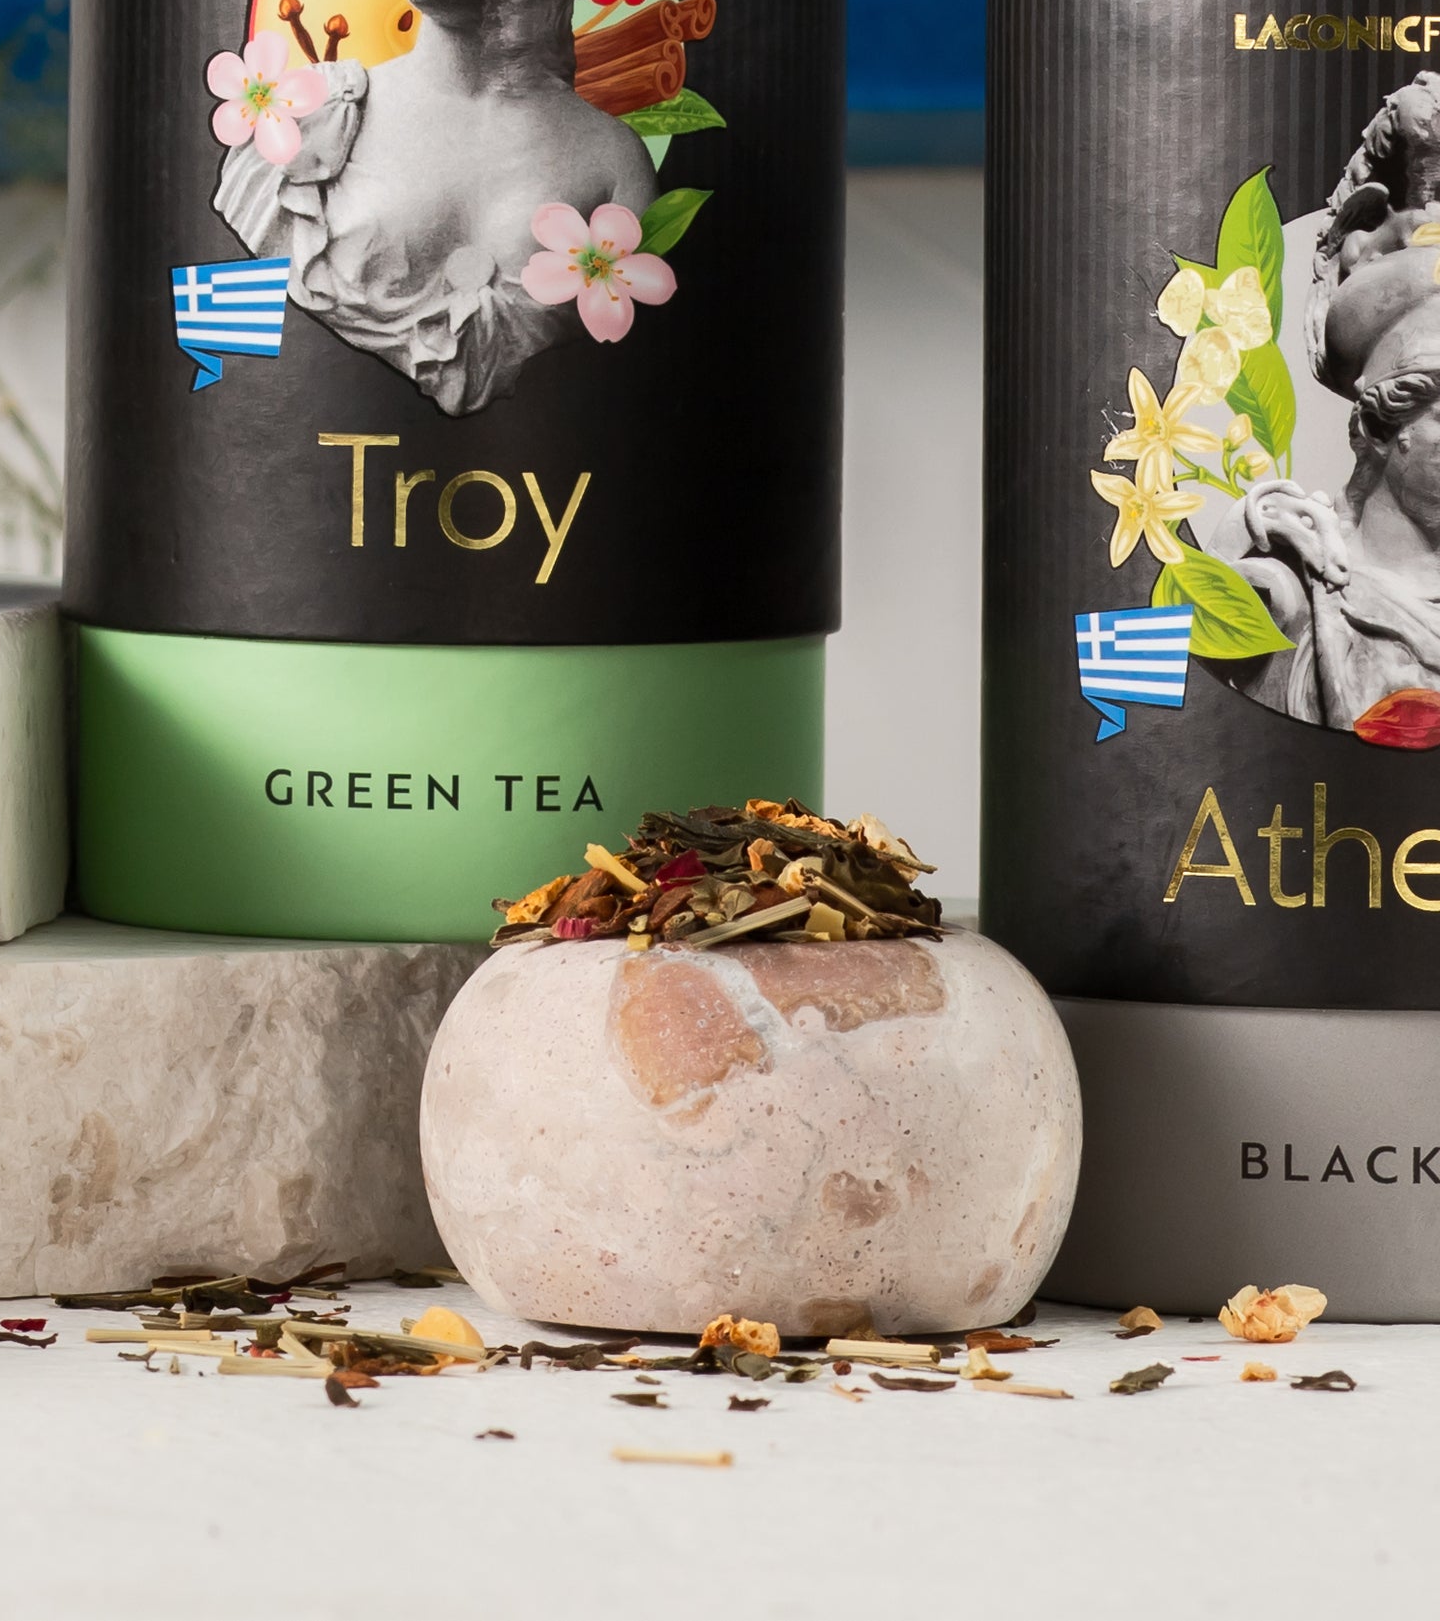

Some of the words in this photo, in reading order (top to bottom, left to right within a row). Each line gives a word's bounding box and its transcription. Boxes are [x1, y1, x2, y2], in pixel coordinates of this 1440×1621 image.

[317, 432, 592, 585] Troy
[265, 769, 458, 810] GREEN
[496, 776, 603, 811] TEA
